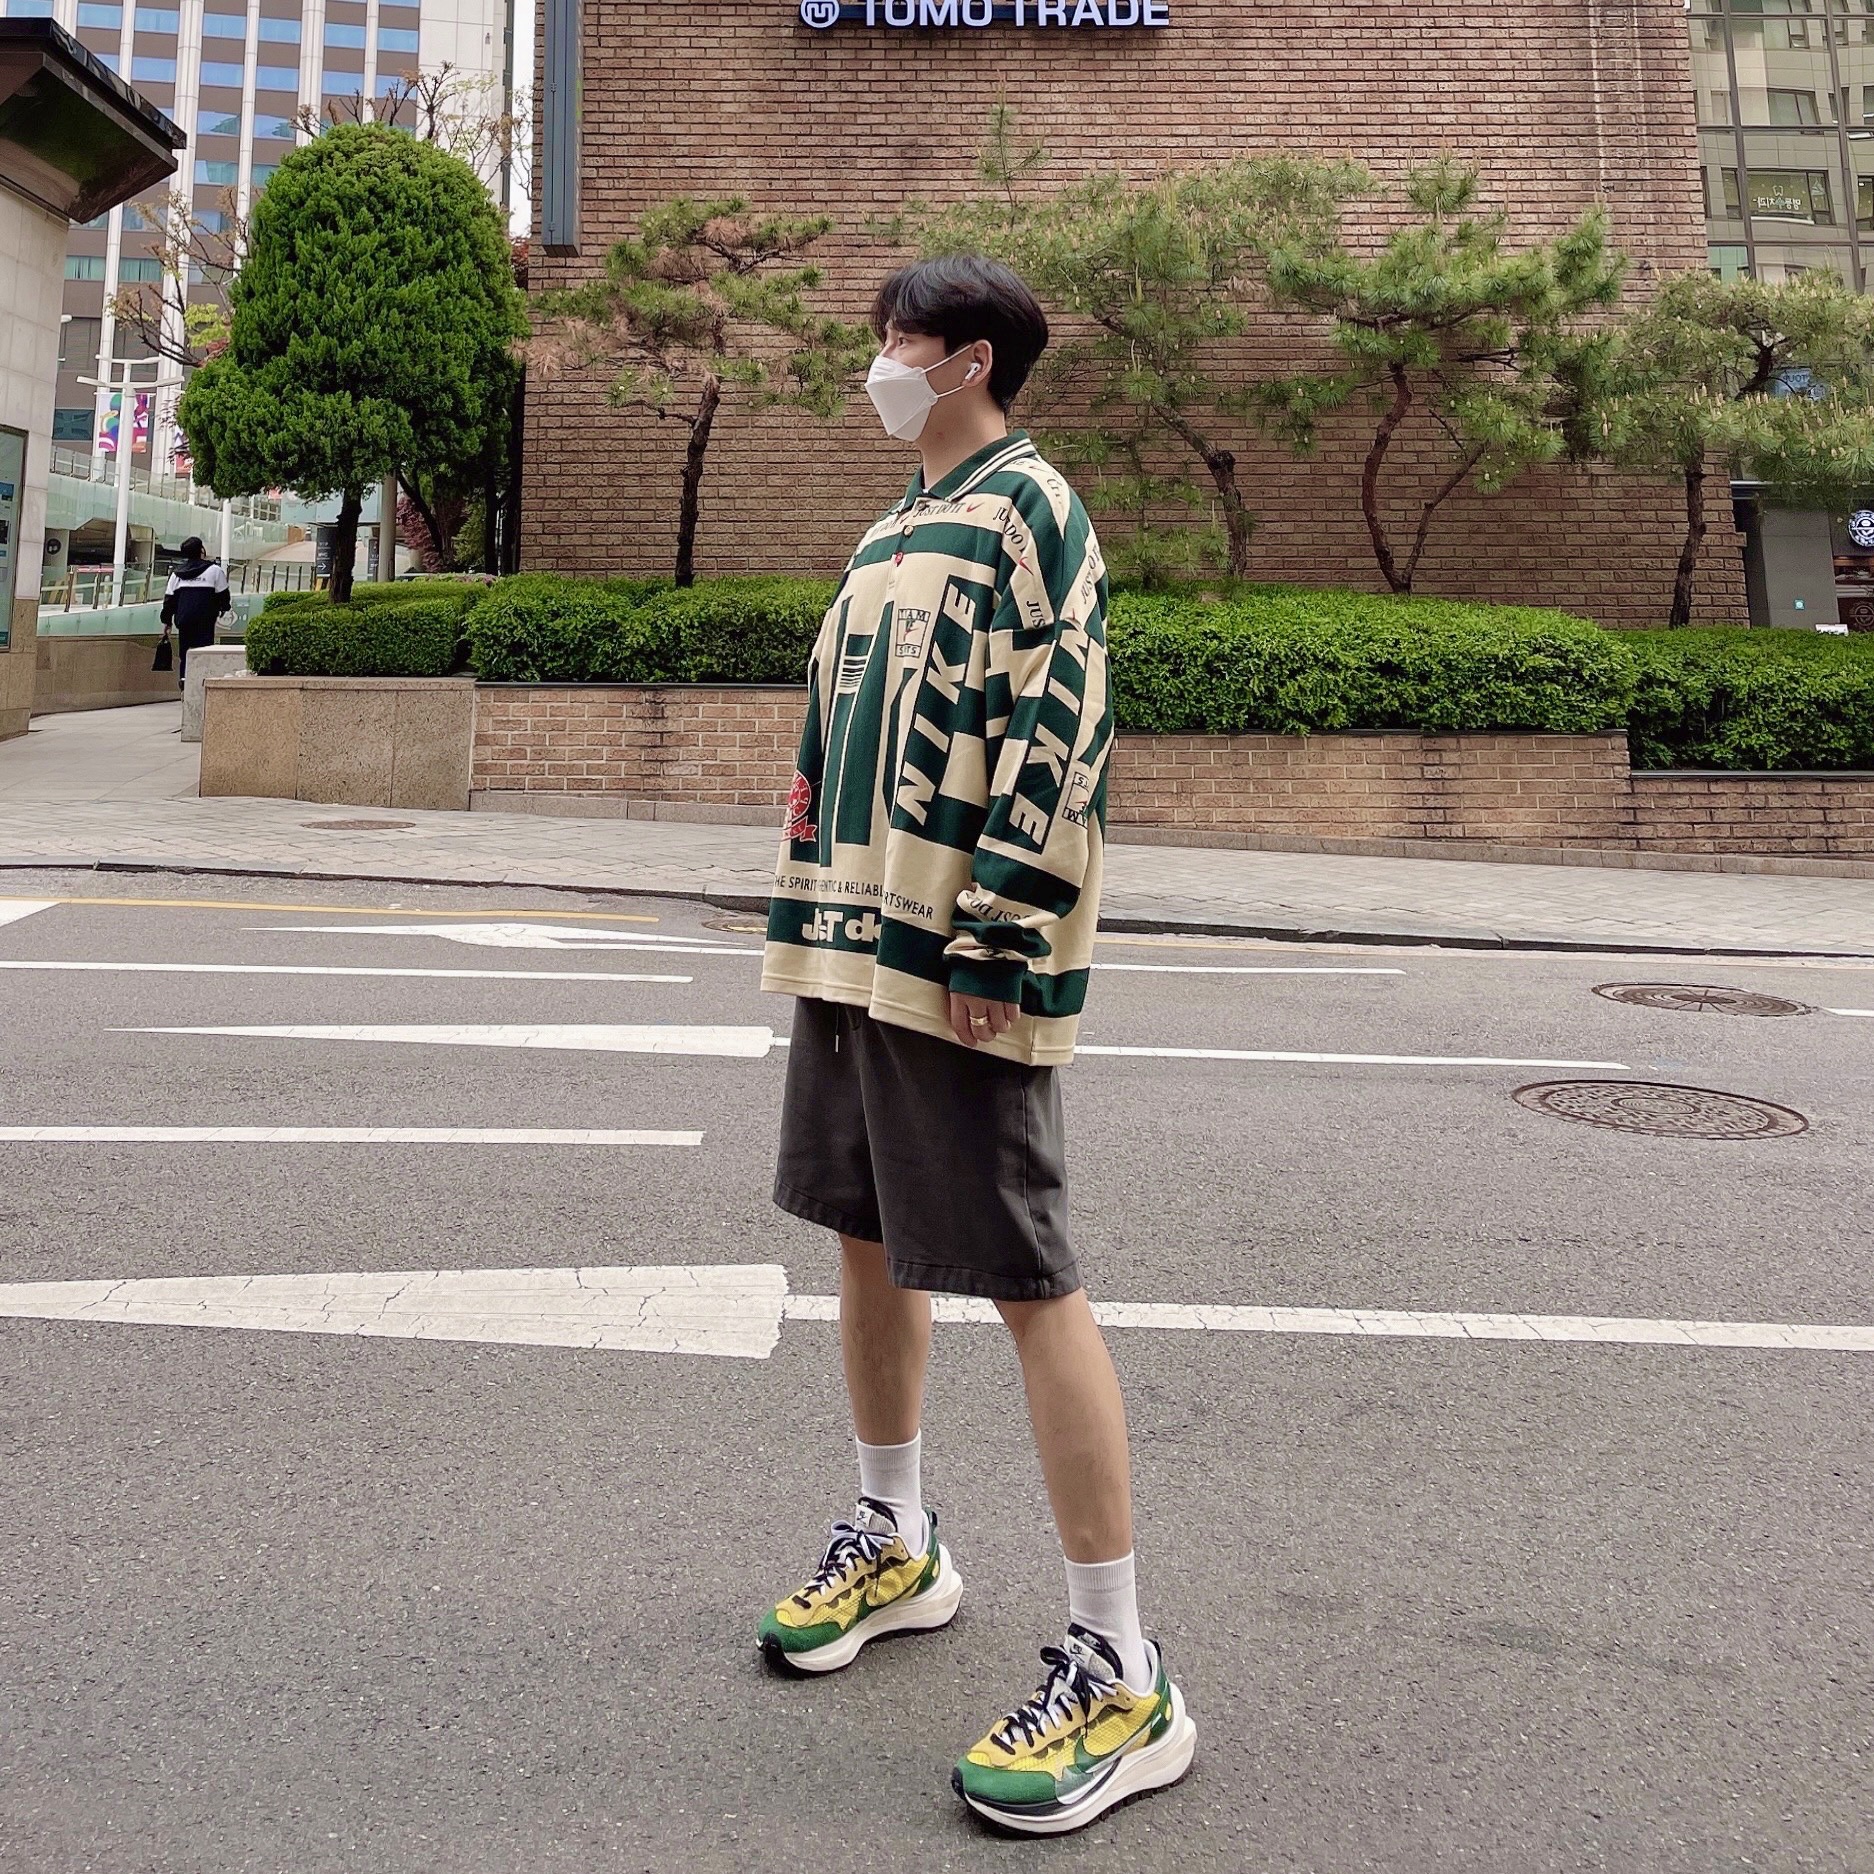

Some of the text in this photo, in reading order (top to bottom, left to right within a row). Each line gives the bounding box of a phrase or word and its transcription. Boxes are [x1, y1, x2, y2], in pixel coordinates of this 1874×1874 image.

[865, 0, 1170, 28] TOMO TRADE
[896, 582, 976, 827] NIKE
[1008, 624, 1089, 847] NIKE
[788, 876, 818, 892] SPIRIT
